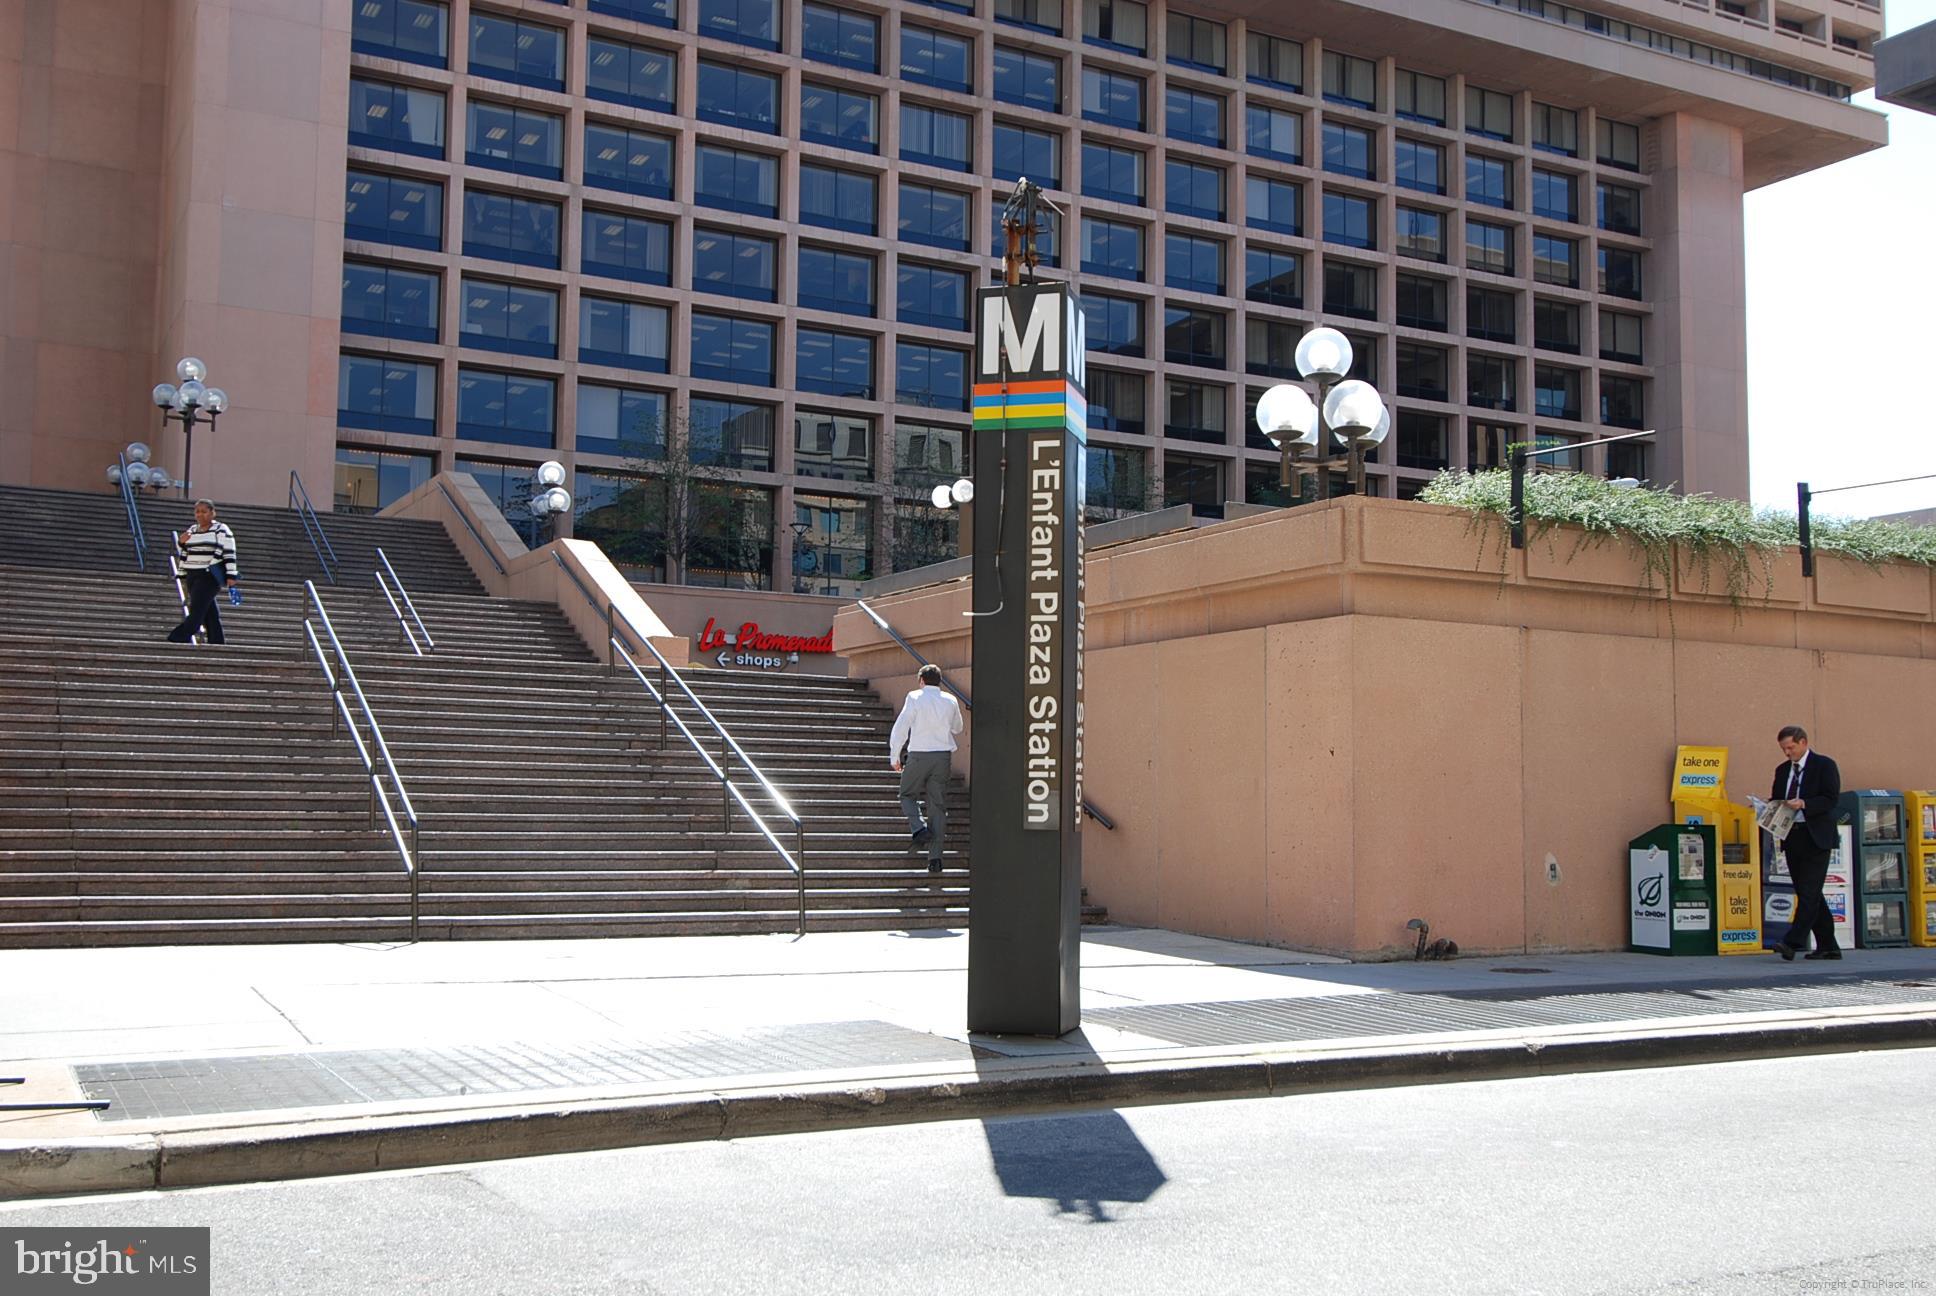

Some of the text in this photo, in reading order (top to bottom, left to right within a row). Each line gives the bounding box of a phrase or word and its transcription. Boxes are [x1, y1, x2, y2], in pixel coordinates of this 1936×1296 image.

[982, 292, 1061, 375] M
[1066, 295, 1086, 389] M
[700, 616, 833, 654] La Promenad
[1027, 439, 1061, 823] L'Enfant Plaza Station
[736, 652, 782, 668] shops
[1682, 756, 1720, 767] take one
[1681, 775, 1717, 785] express
[1723, 869, 1753, 880] free daily
[1729, 896, 1748, 906] take
[1730, 906, 1748, 915] one
[1721, 931, 1757, 942] express
